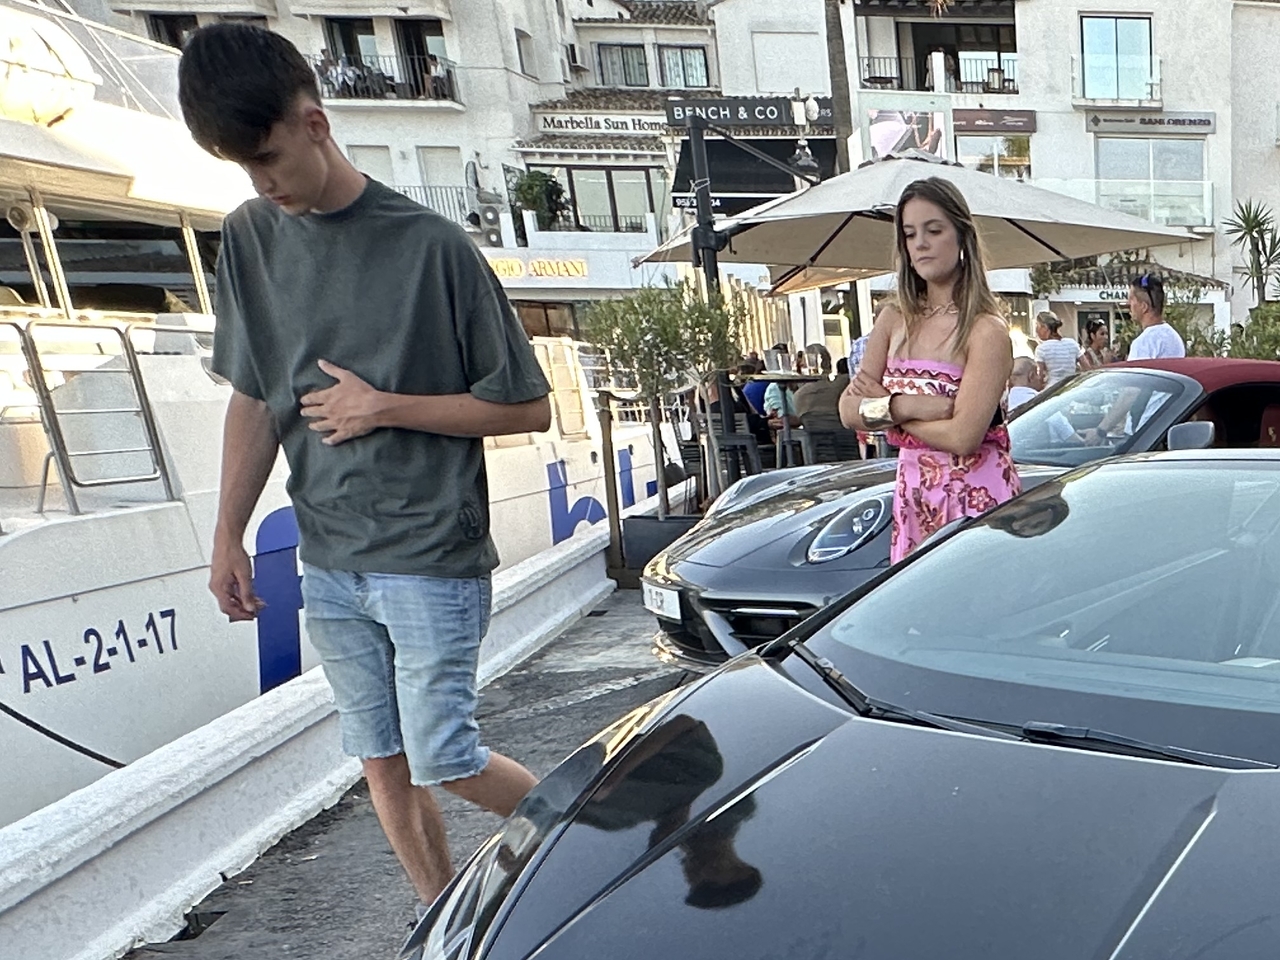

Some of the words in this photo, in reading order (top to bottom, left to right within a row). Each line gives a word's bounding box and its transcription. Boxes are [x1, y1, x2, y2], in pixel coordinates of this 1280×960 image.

[673, 106, 730, 120] BENCH
[738, 107, 748, 119] &
[755, 106, 778, 120] CO
[542, 116, 602, 130] Marbella
[604, 117, 629, 130] Sun
[631, 118, 669, 132] Home
[493, 260, 522, 277] GIO
[528, 260, 587, 277] ARMANI
[1099, 290, 1129, 300] CHAN
[20, 608, 178, 694] AL-2-1-17
